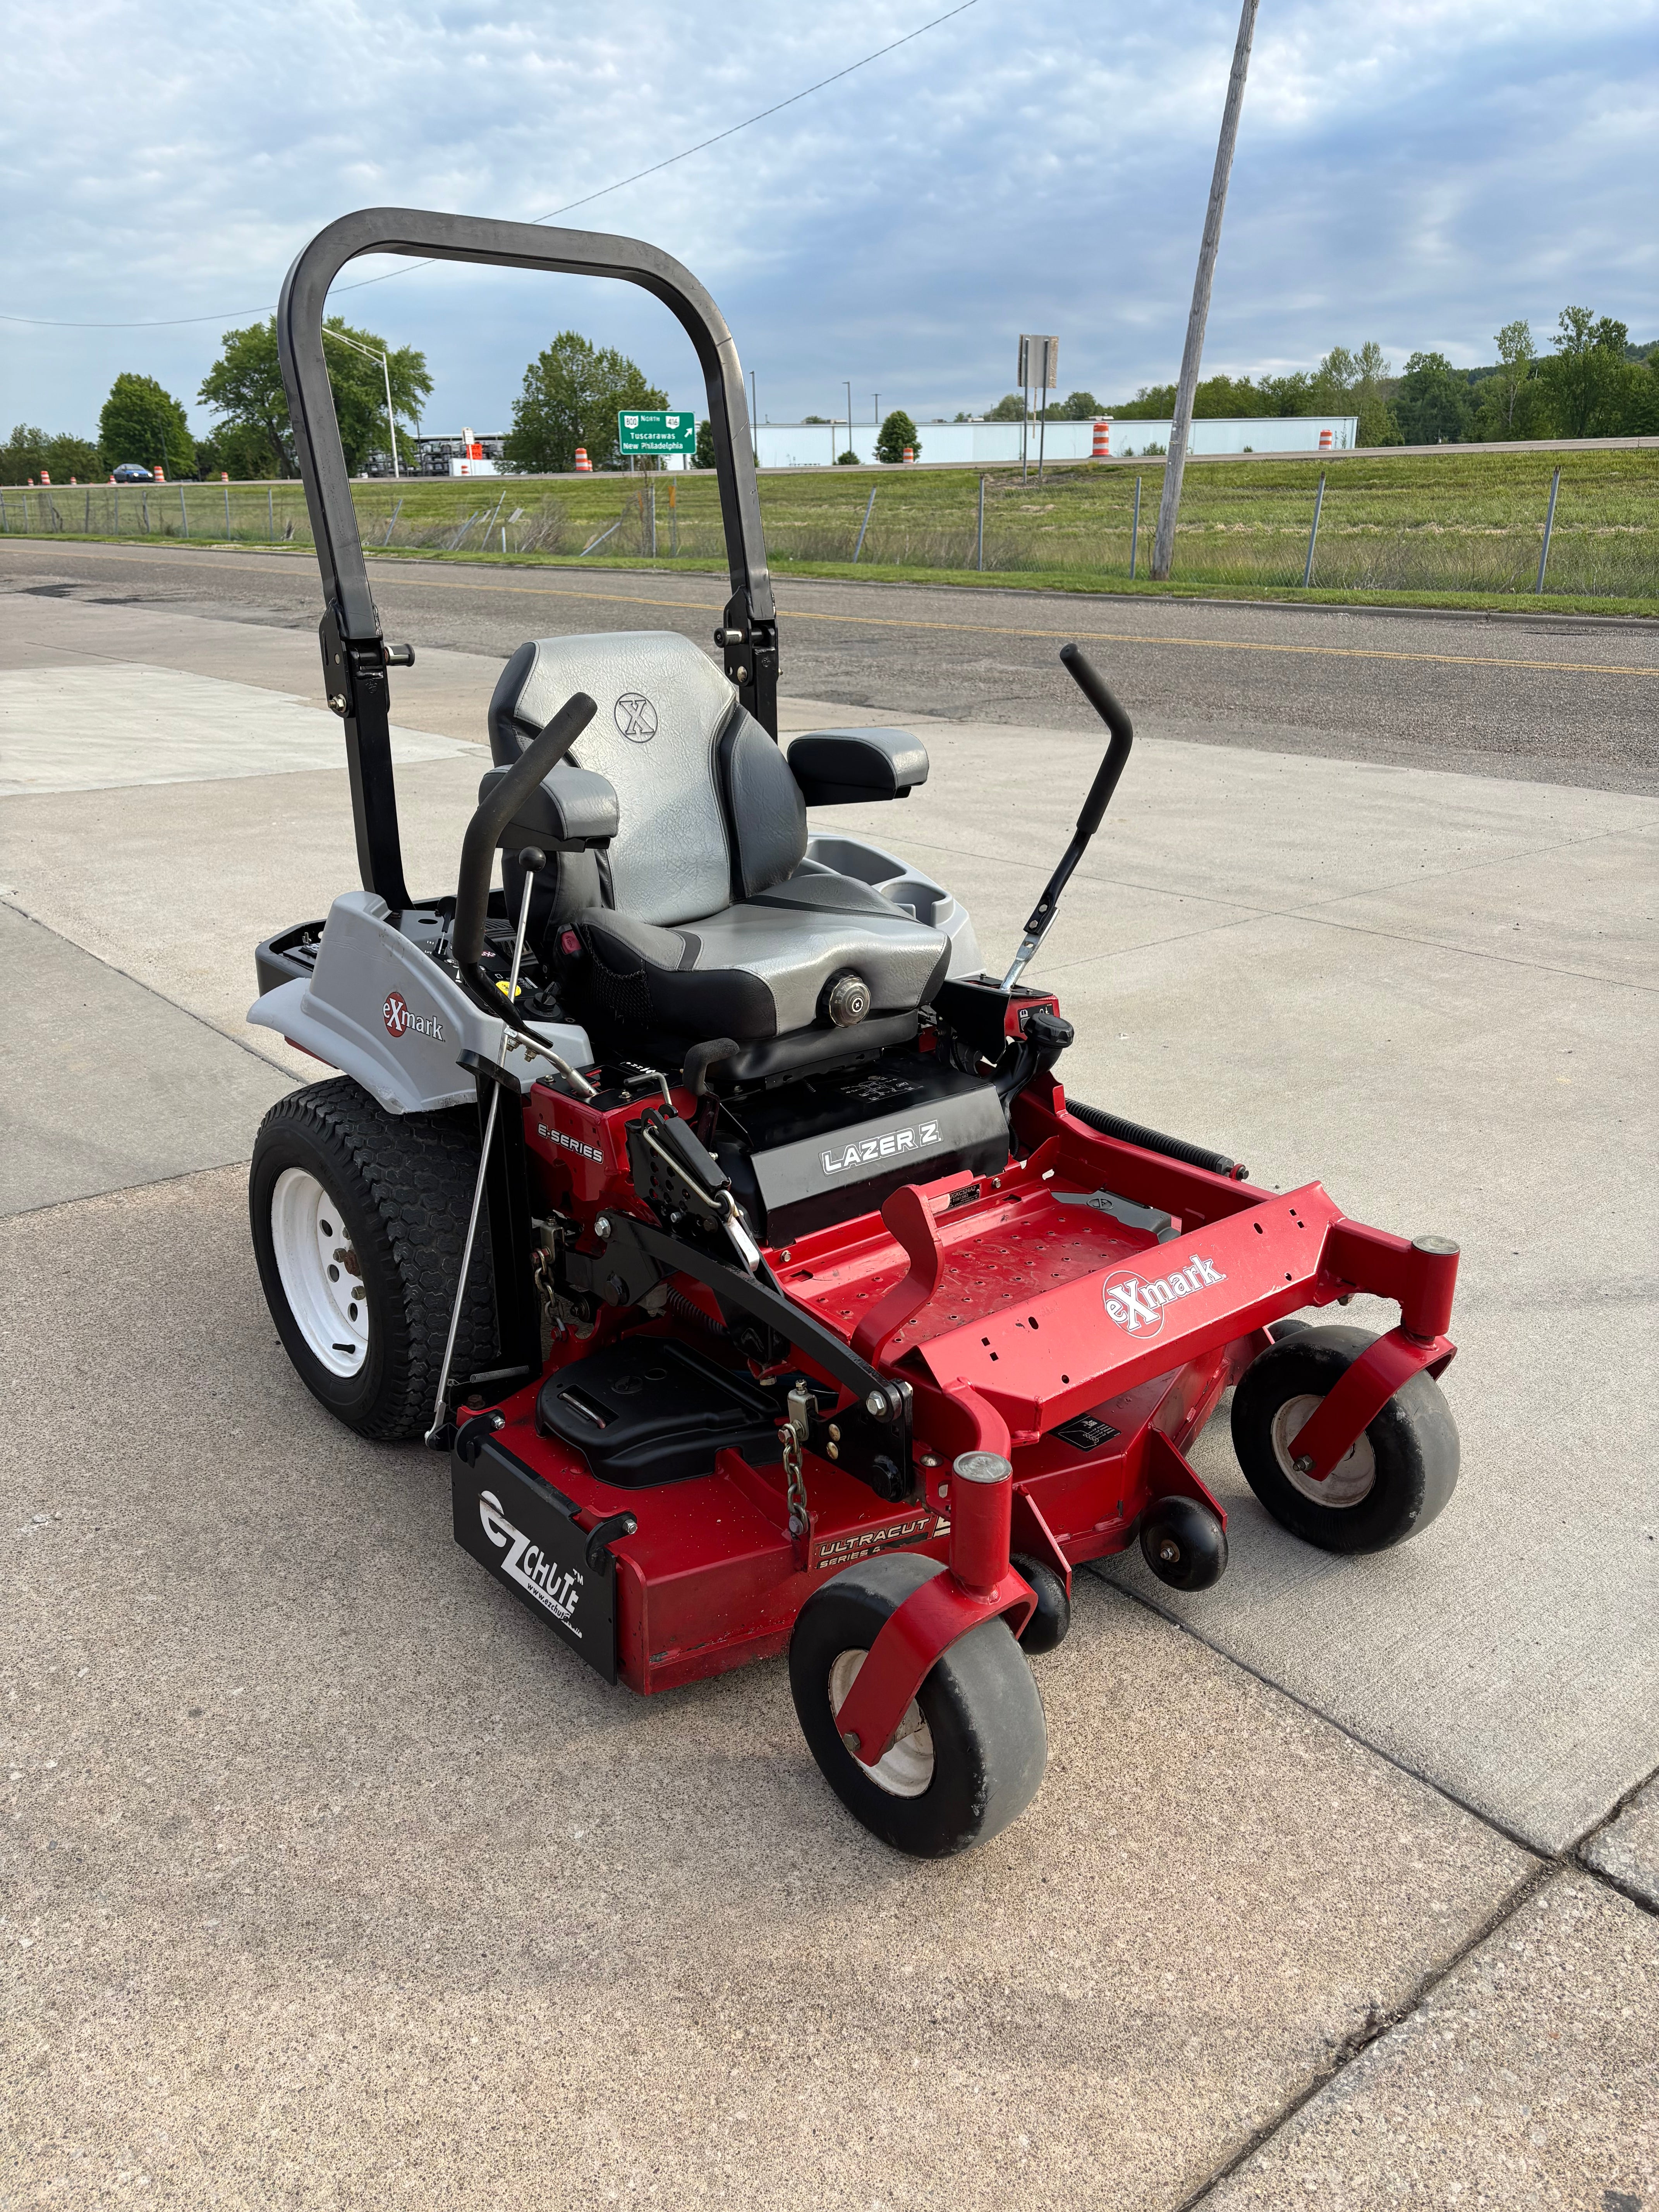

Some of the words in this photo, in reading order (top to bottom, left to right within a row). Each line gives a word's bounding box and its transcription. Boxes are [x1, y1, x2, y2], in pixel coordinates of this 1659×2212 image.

[641, 442, 683, 450] Philadelphia
[538, 1123, 602, 1162] E-SERIES
[825, 1131, 913, 1171] LAZER
[921, 1123, 937, 1143] Z
[820, 1518, 930, 1556] ULTRACUT
[819, 1549, 868, 1568] SERIES
